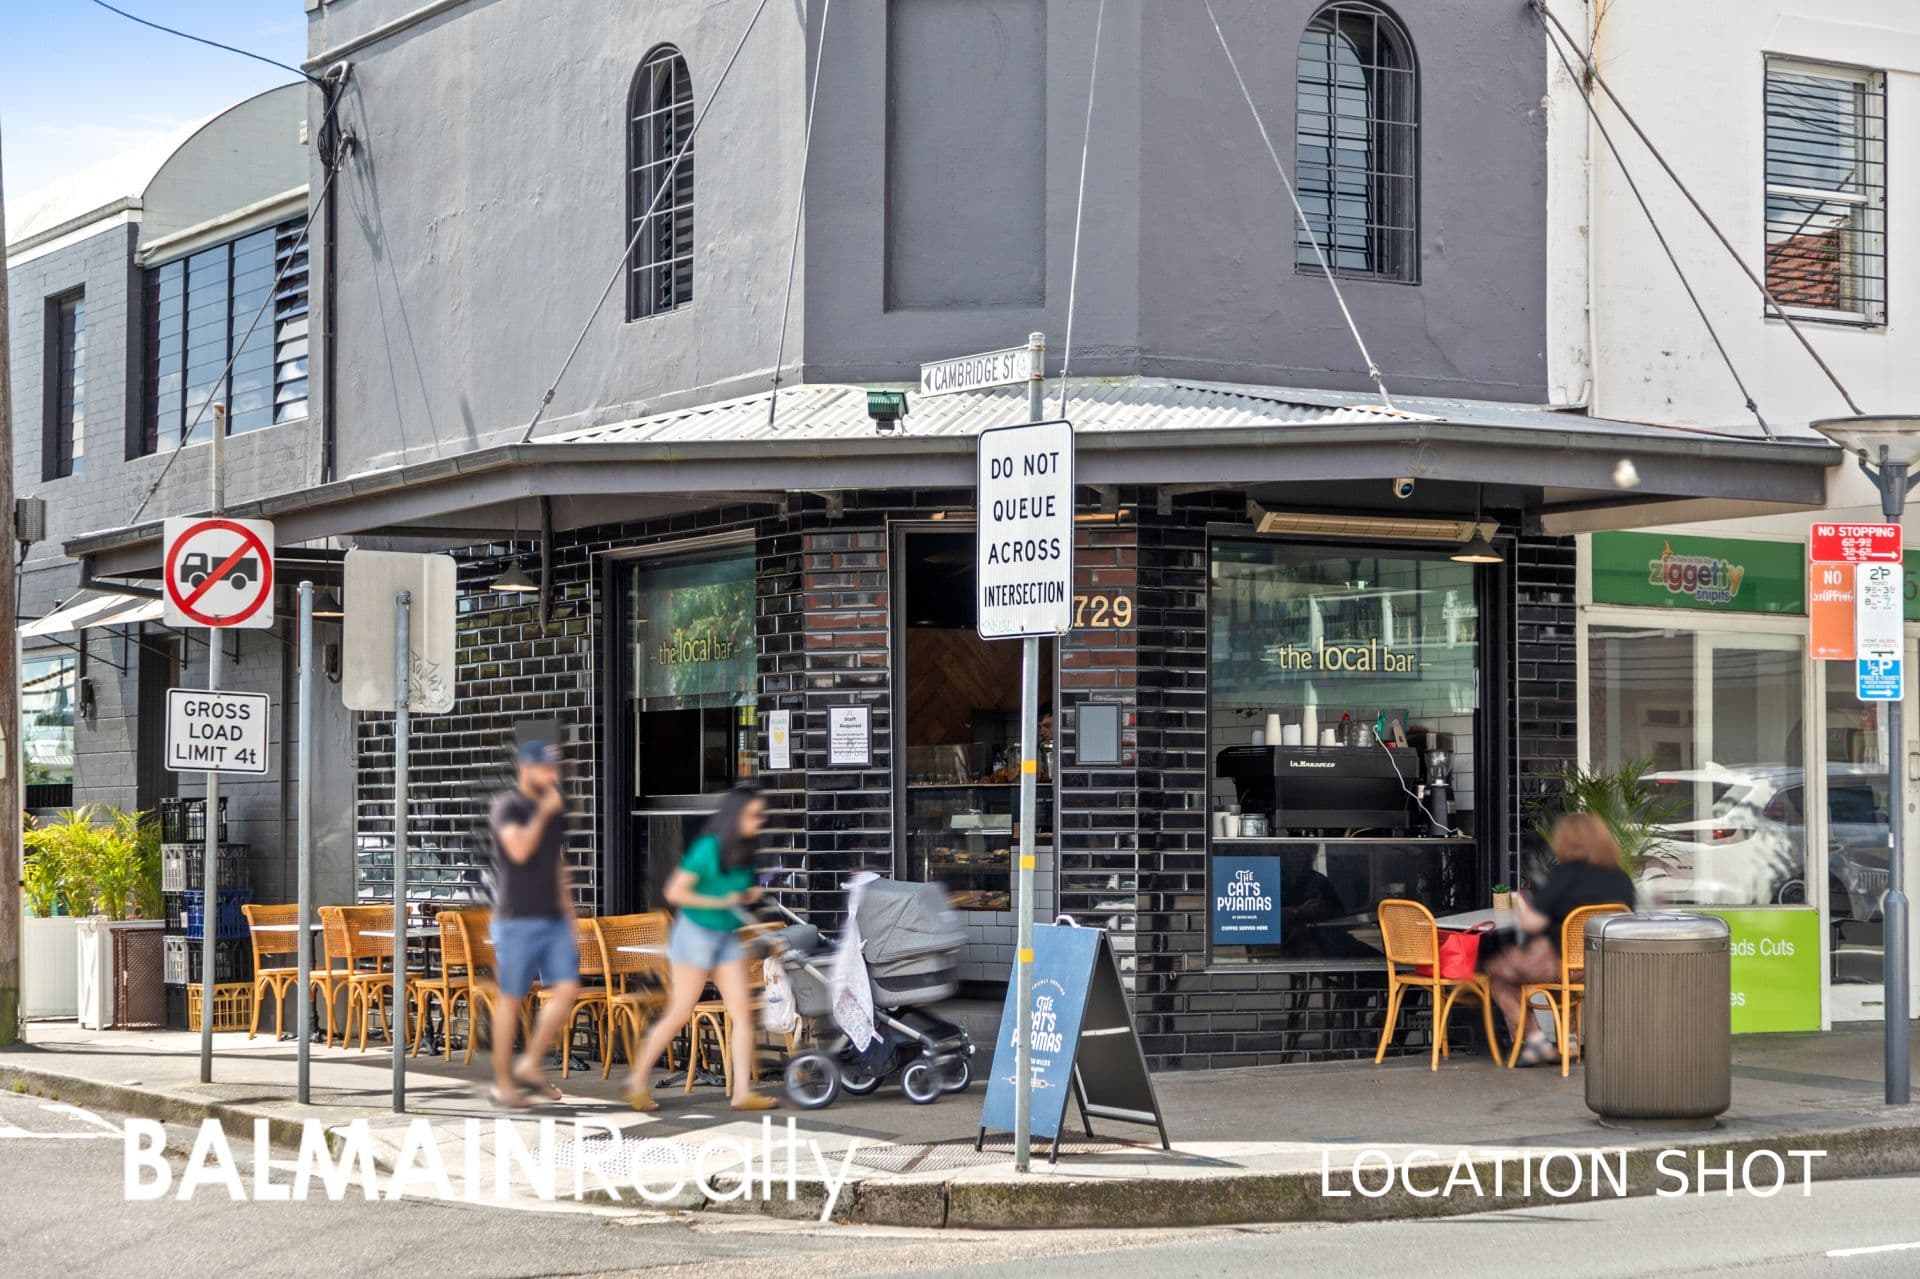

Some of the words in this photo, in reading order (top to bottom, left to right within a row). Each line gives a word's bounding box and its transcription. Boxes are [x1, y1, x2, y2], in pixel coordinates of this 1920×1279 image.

[934, 356, 999, 391] CAMBRIDGE
[1002, 353, 1015, 380] ST
[991, 456, 1013, 480] DO
[1023, 451, 1059, 476] NOT
[993, 495, 1056, 522] QUEUE
[1817, 526, 1835, 537] NO
[1838, 527, 1895, 538] STOPPING
[988, 537, 1061, 565] ACROSS
[1648, 553, 1744, 597] ziggetty
[1823, 569, 1842, 585] NO
[1870, 568, 1891, 581] 2P
[984, 581, 1064, 607] INTERSECTION
[1073, 595, 1132, 628] 729
[659, 640, 676, 665] the
[678, 628, 711, 663] local
[714, 636, 732, 660] bar
[1279, 643, 1312, 669] the
[1318, 636, 1377, 671] local
[1383, 646, 1415, 672] bar
[184, 701, 251, 720] GROSS
[189, 722, 243, 741] LOAD
[176, 744, 227, 762] LIMIT
[234, 748, 257, 765] 4t
[1227, 882, 1260, 896] CAT'S
[1217, 896, 1272, 912] PYJAMAS
[1760, 938, 1795, 956] Cuts
[1031, 1011, 1056, 1033] AT'S
